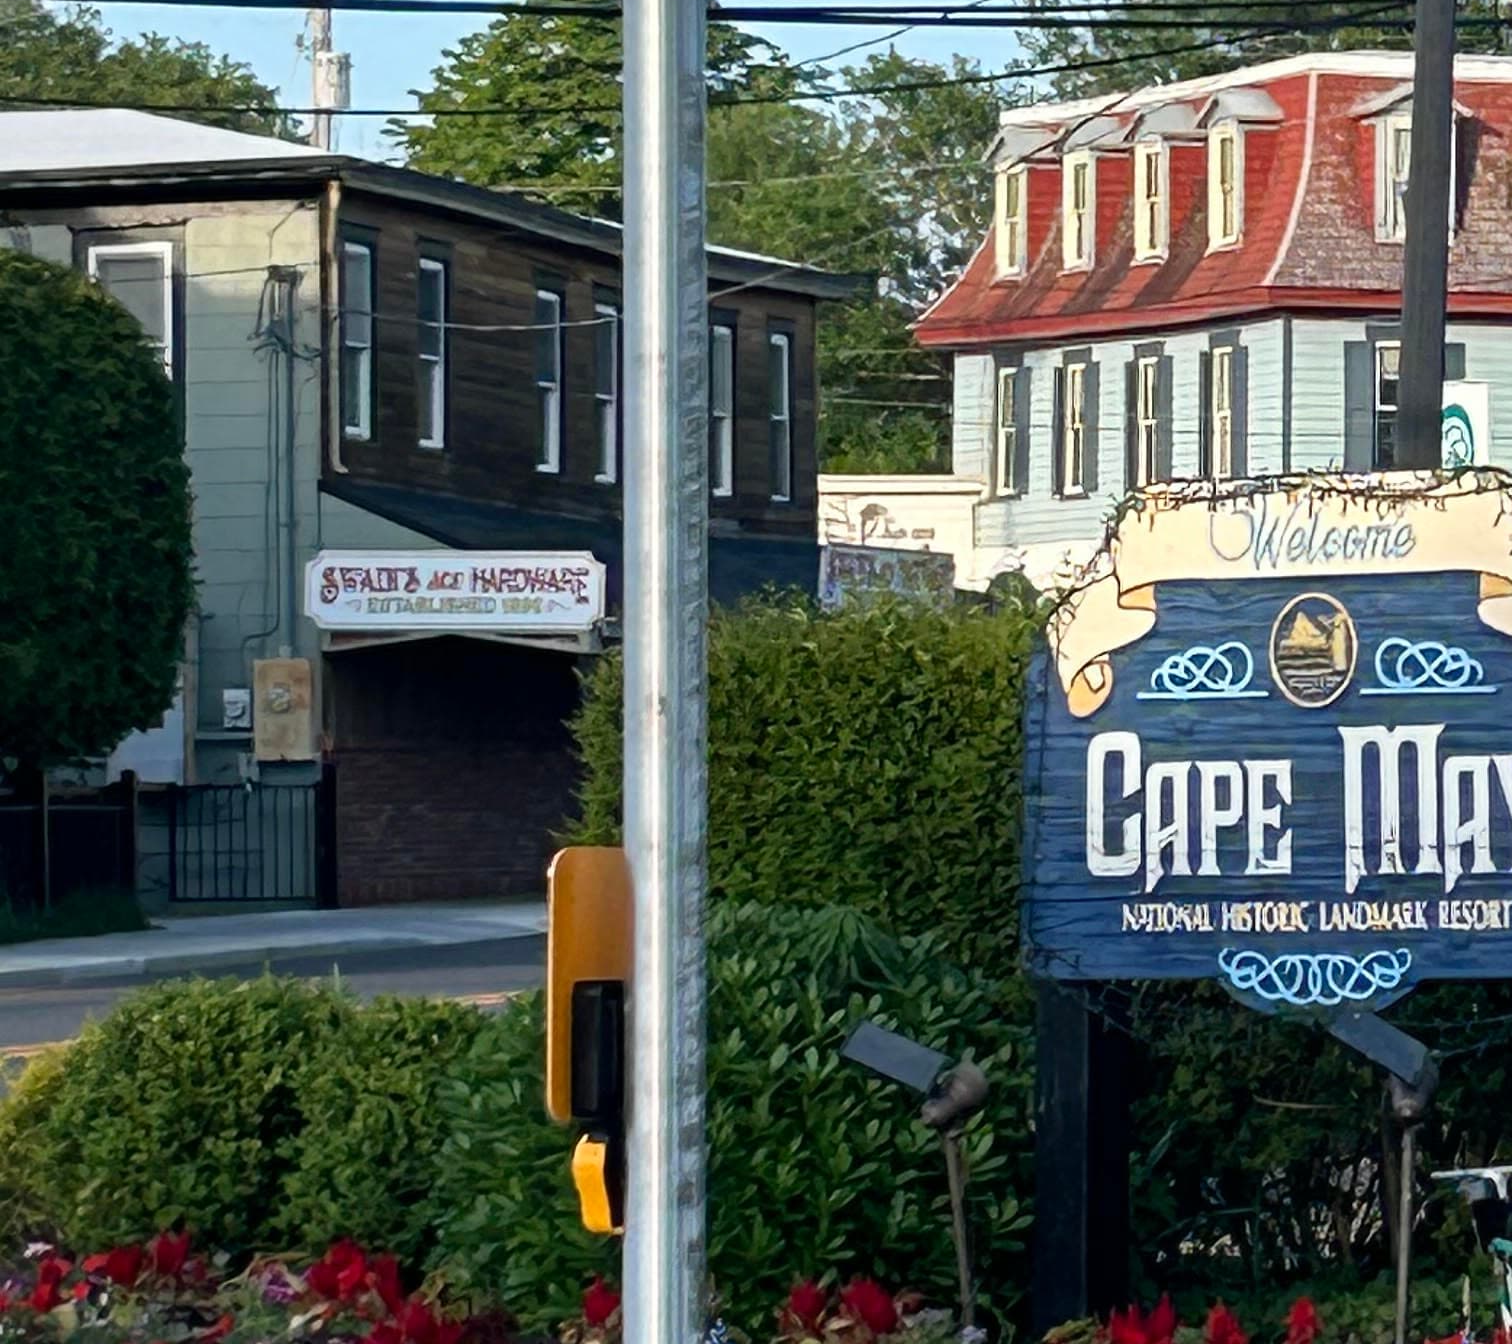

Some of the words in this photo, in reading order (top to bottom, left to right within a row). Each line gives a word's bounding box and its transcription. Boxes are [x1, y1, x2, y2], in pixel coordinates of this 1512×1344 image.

[1210, 498, 1416, 571] Welcome
[1086, 731, 1292, 893] CAPE
[1122, 902, 1214, 932] NATIONAL
[1221, 901, 1309, 933] HISTORIC
[1319, 900, 1428, 932] LANDMARK
